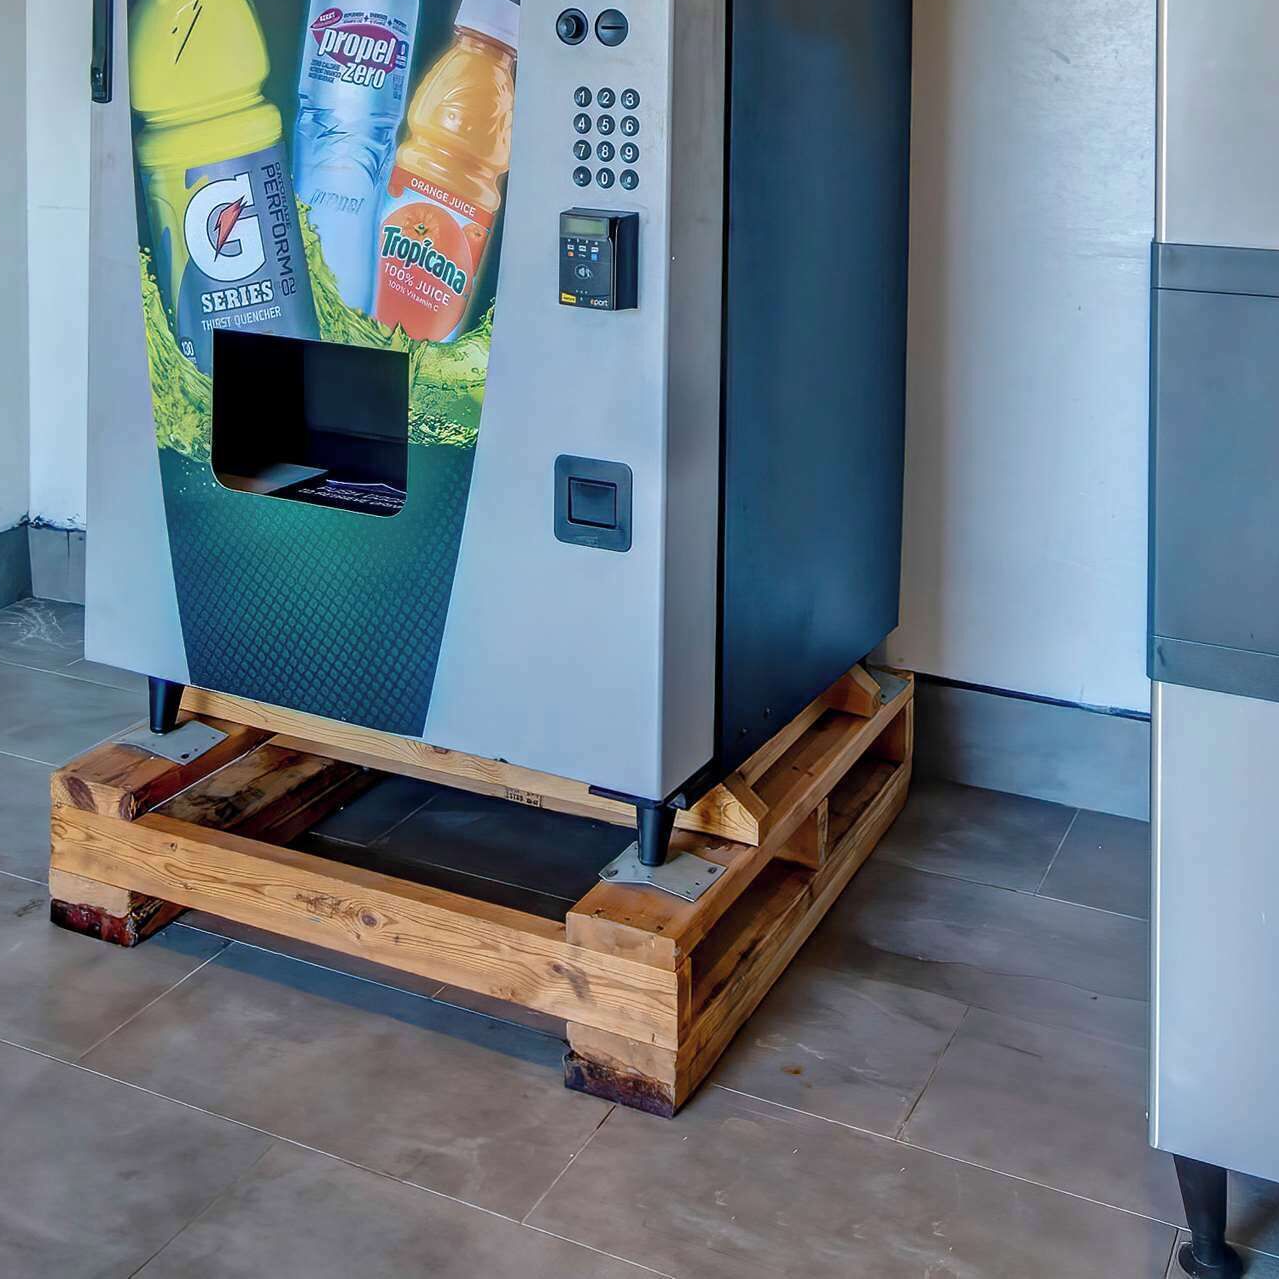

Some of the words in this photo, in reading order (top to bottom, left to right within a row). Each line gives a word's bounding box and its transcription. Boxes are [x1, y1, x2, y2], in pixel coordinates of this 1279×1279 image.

[319, 29, 397, 64] propel
[342, 63, 386, 89] zero
[579, 90, 585, 104] 1
[602, 92, 610, 104] 2
[625, 93, 634, 106] 3
[578, 117, 585, 130] 4
[601, 118, 609, 131] 5
[625, 120, 633, 132] 6
[578, 144, 585, 157] 7
[601, 145, 609, 157] 8
[625, 146, 633, 160] 9
[601, 172, 608, 185] 0
[411, 178, 449, 202] ORANGE
[449, 197, 477, 217] JUICE
[184, 171, 267, 282] G
[261, 163, 294, 277] PERFORM
[381, 225, 468, 296] Tropicana
[201, 280, 274, 313] SERIES
[384, 262, 415, 287] 100%
[415, 280, 451, 306] JUICE
[388, 280, 407, 296] 100%
[407, 289, 433, 310] Vitamin
[433, 304, 440, 312] C
[201, 315, 232, 331] THIRST
[234, 306, 282, 328] QUENCHER
